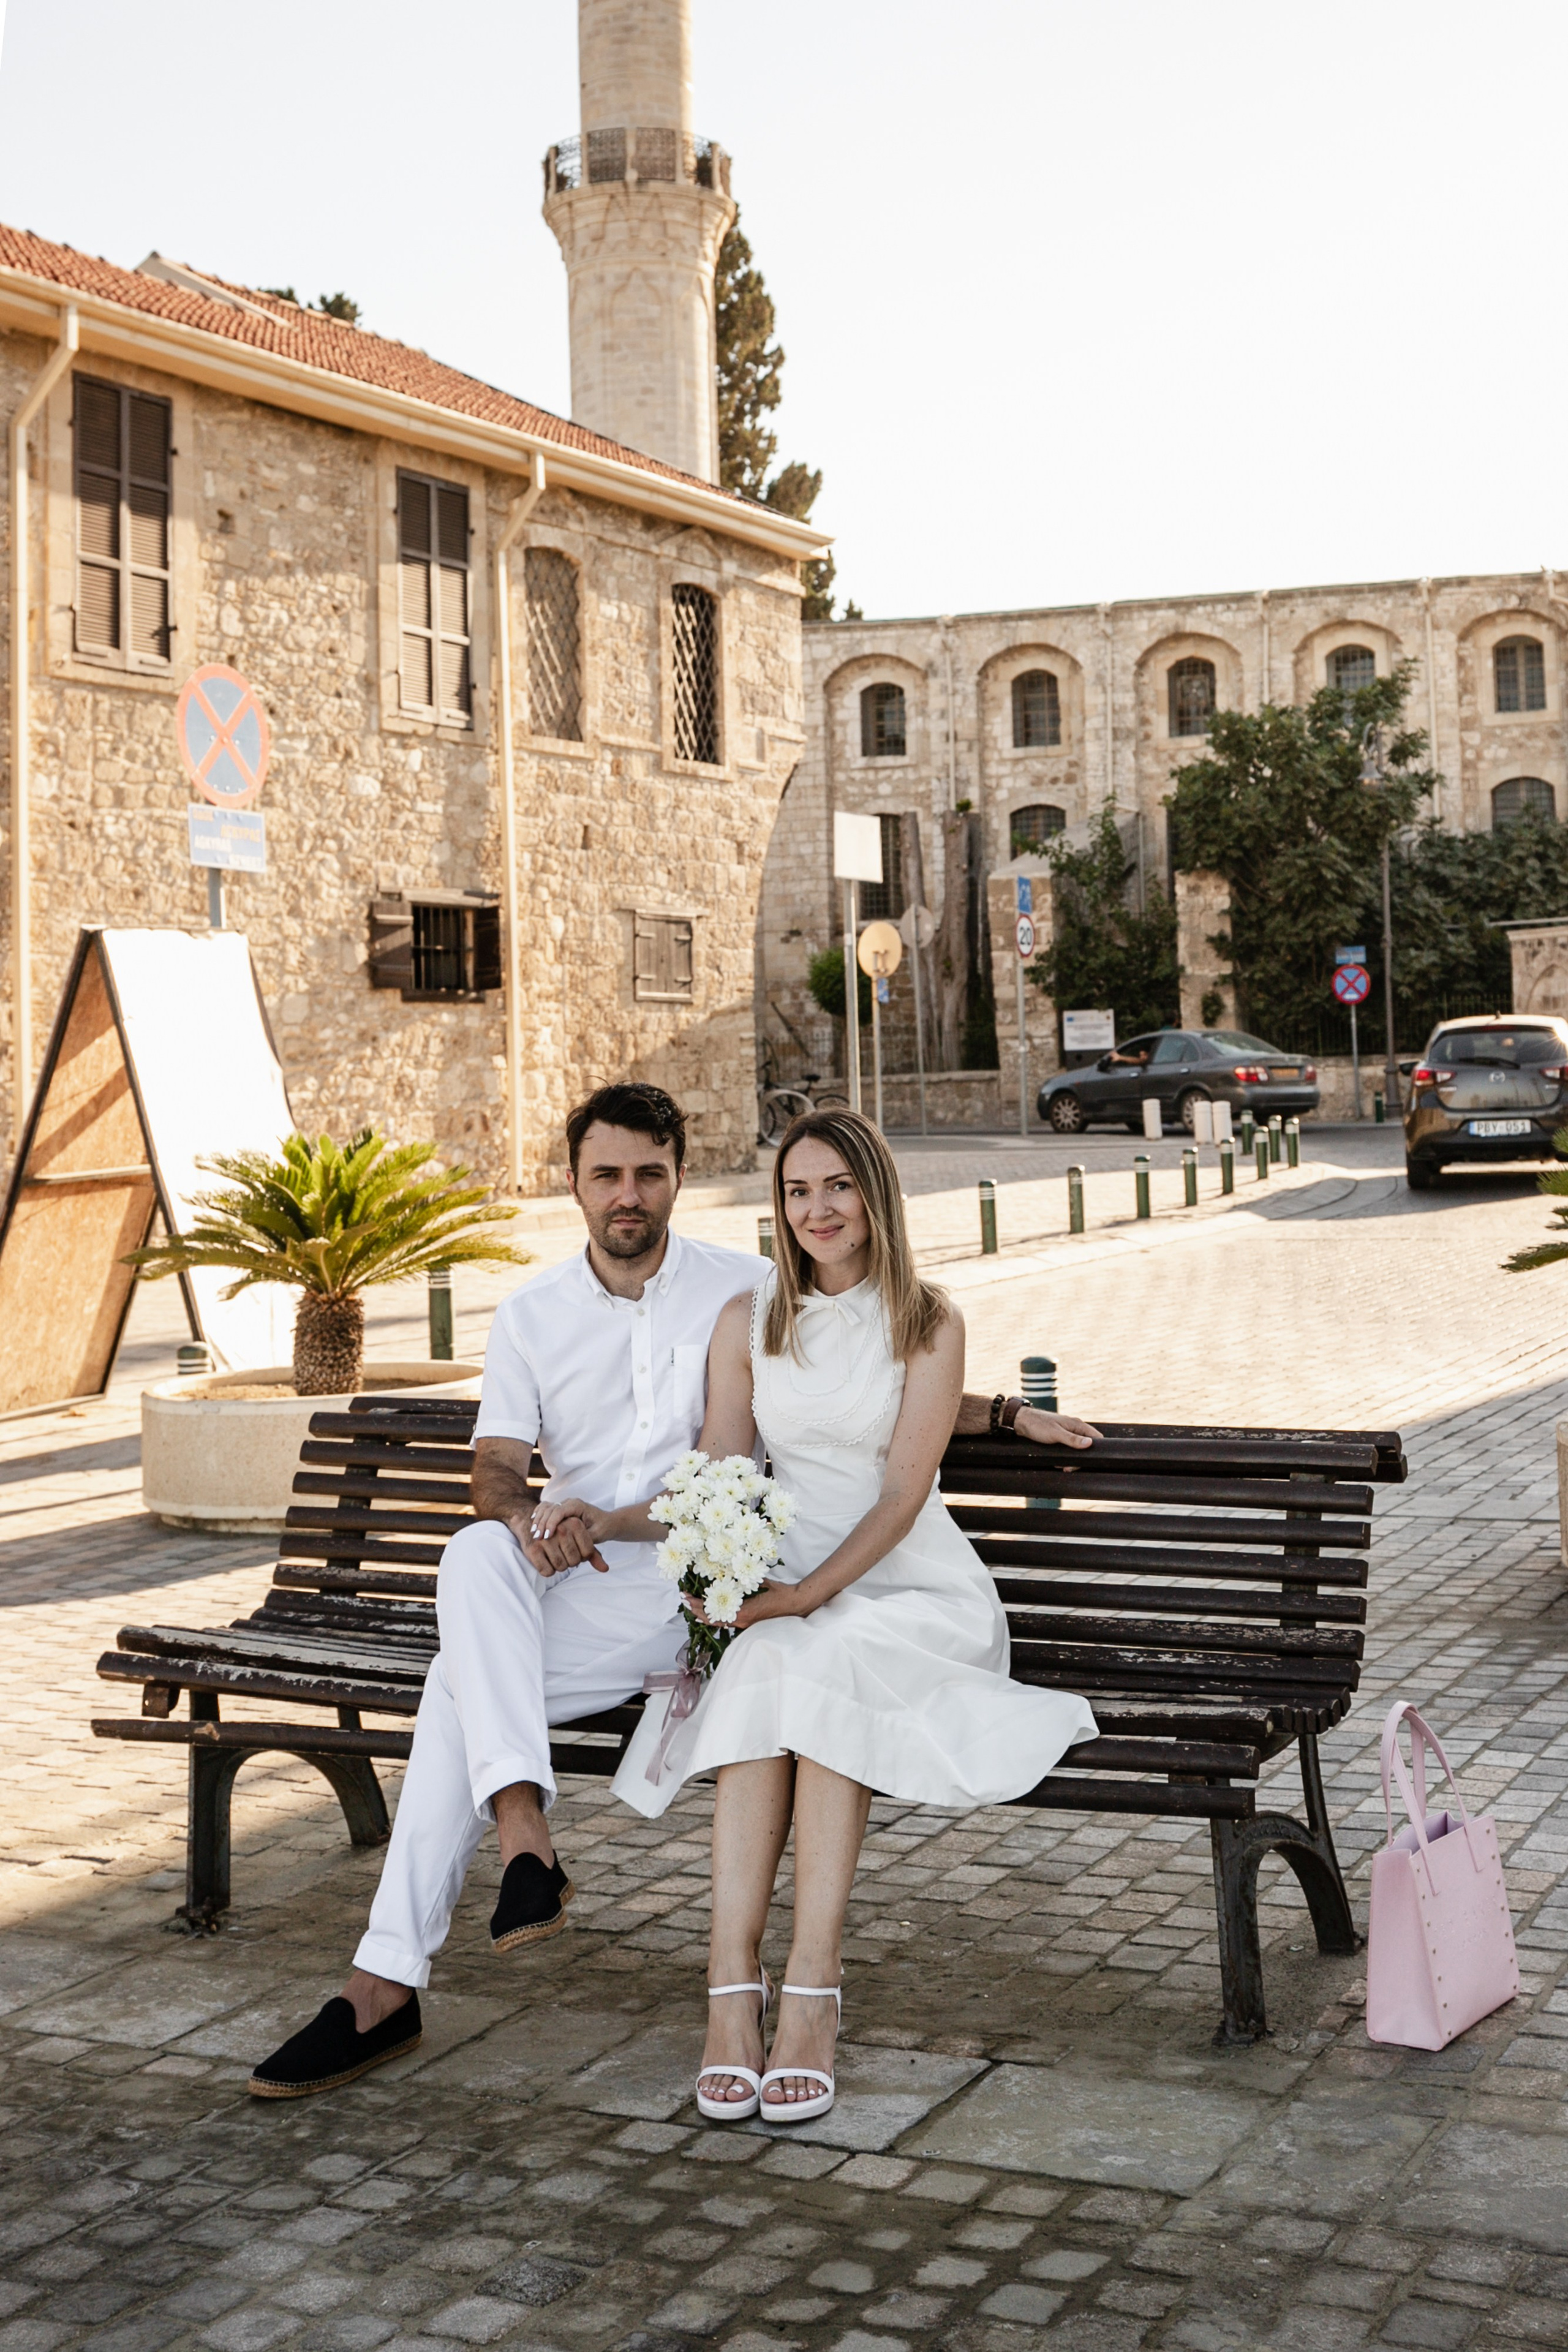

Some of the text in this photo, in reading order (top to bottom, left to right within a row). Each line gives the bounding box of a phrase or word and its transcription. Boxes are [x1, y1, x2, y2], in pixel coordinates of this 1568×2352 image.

[1020, 926, 1032, 945] 20
[1477, 1121, 1526, 1133] PBY 051
